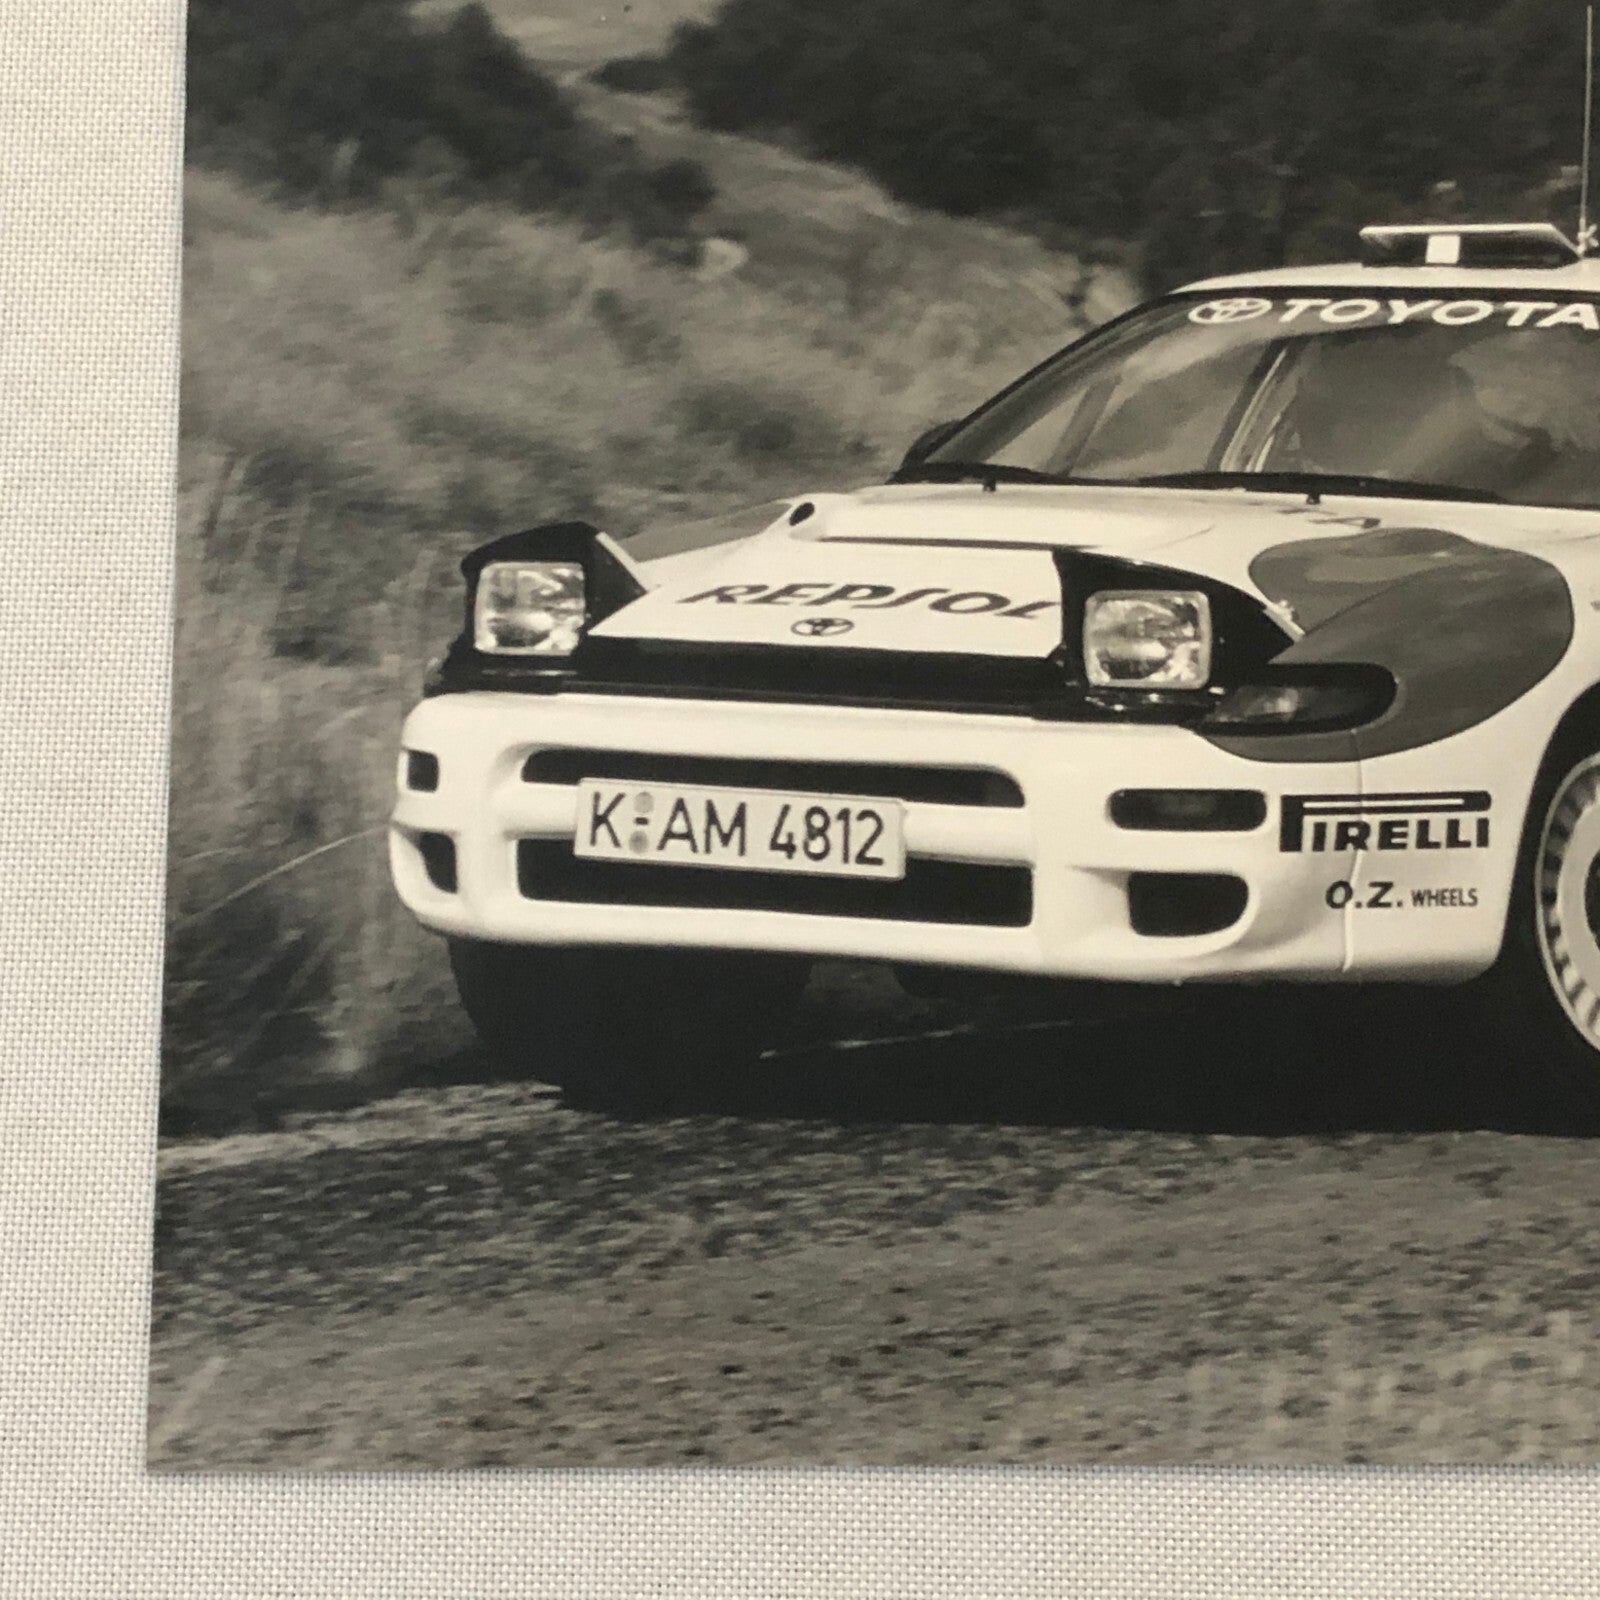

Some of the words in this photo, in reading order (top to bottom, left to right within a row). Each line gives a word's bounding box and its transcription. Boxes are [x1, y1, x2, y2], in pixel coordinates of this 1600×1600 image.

[1279, 298, 1599, 330] TOYOTA
[677, 582, 1061, 619] REPSOL
[769, 803, 884, 867] 4812
[1279, 790, 1492, 853] PIRELLI
[1326, 880, 1403, 909] O.Z.
[1411, 888, 1478, 907] WHEELS
